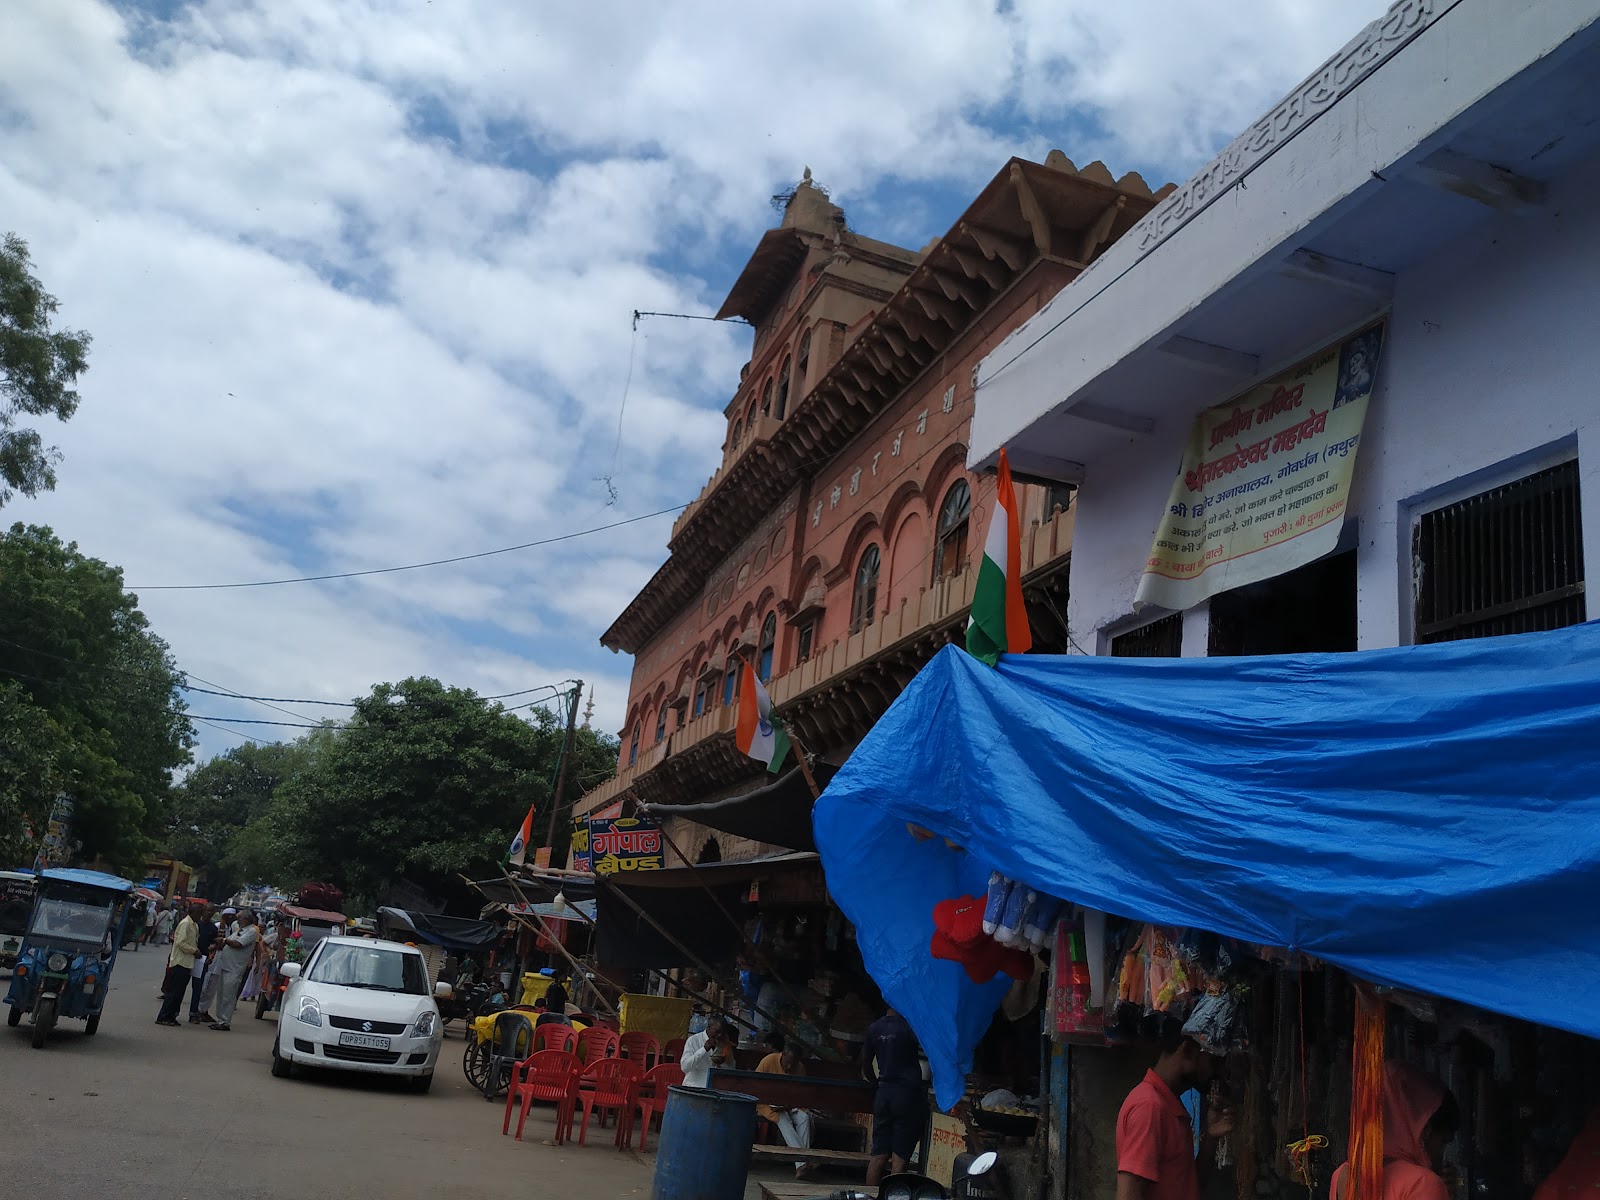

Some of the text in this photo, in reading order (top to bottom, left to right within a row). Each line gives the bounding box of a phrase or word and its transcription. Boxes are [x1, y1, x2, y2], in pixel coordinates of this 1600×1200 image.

[1208, 407, 1255, 451] प्राचीन
[1272, 408, 1329, 454] महादेव
[1170, 502, 1188, 518] श्री
[1215, 474, 1274, 504] अनाथालय,
[1277, 452, 1319, 479] गोवर्धन
[1234, 502, 1247, 515] जो
[1248, 497, 1267, 510] काम
[1269, 488, 1284, 502] करे
[1316, 470, 1330, 482] का
[1156, 540, 1180, 552] काल
[1181, 542, 1195, 553] भी
[1207, 529, 1222, 540] क्या
[1241, 515, 1254, 528] जो
[1254, 510, 1275, 524] भक्त
[1277, 503, 1287, 517] हो
[1288, 489, 1325, 511] महाकाल
[1326, 482, 1339, 495] का
[1295, 514, 1306, 528] श्री
[592, 823, 661, 855] गोपाल
[594, 854, 663, 873] बैण्ड
